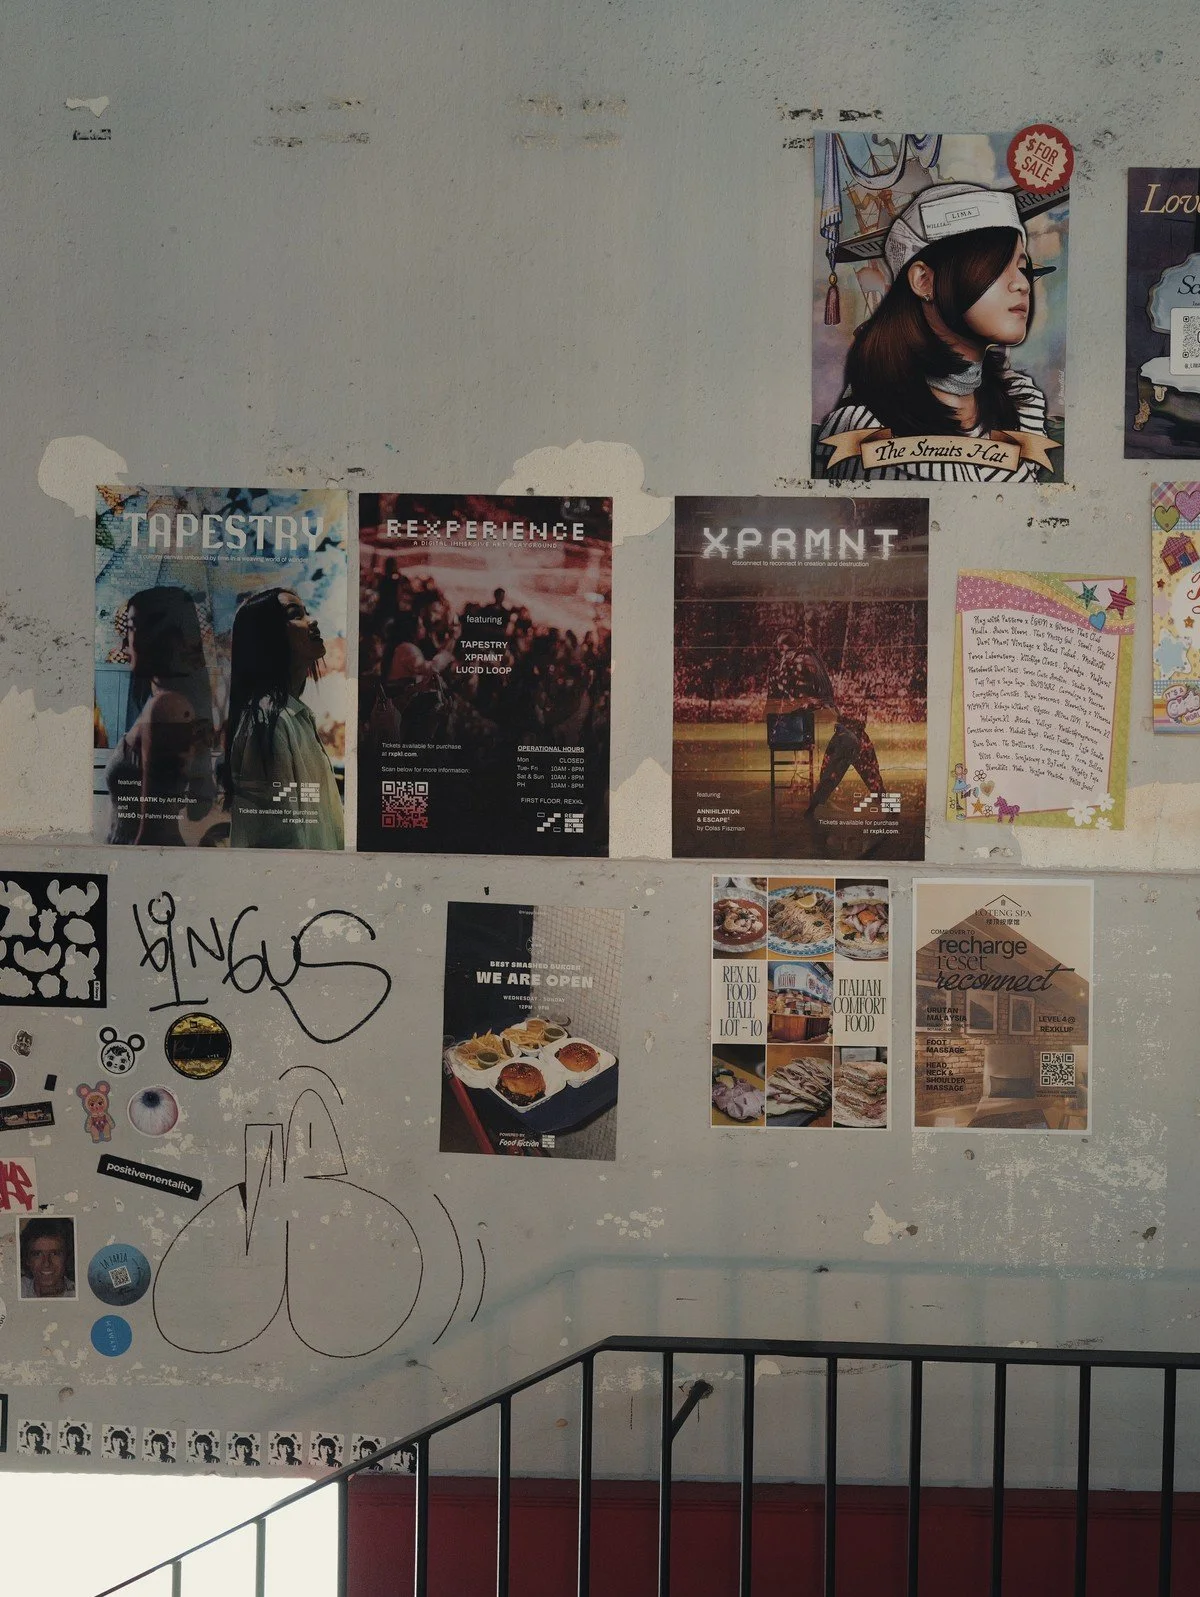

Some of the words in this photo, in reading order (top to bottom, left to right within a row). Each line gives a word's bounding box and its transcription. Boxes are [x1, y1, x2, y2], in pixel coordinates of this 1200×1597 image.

[1021, 160, 1053, 187] SALE
[952, 211, 972, 219] LIMA
[875, 441, 905, 461] The
[911, 439, 962, 457] Straits
[966, 443, 1010, 463] Hat
[124, 513, 324, 550] TAPESTRY
[387, 519, 584, 541] REXPERIENCE
[466, 615, 502, 625] featuring
[938, 936, 1027, 959] recharge
[938, 954, 987, 970] reset
[476, 972, 502, 984] WE
[507, 973, 540, 986] ARE
[546, 974, 593, 988] OPEN
[723, 966, 744, 983] REX
[746, 966, 761, 984] KL
[937, 963, 1075, 992] reconnect
[726, 984, 757, 1001] FOOD
[839, 979, 881, 996] ITALIAN
[727, 1001, 756, 1019] HALL
[833, 997, 886, 1014] COMFORT
[845, 1015, 875, 1032] FOOD
[106, 1162, 194, 1193] positivementality
